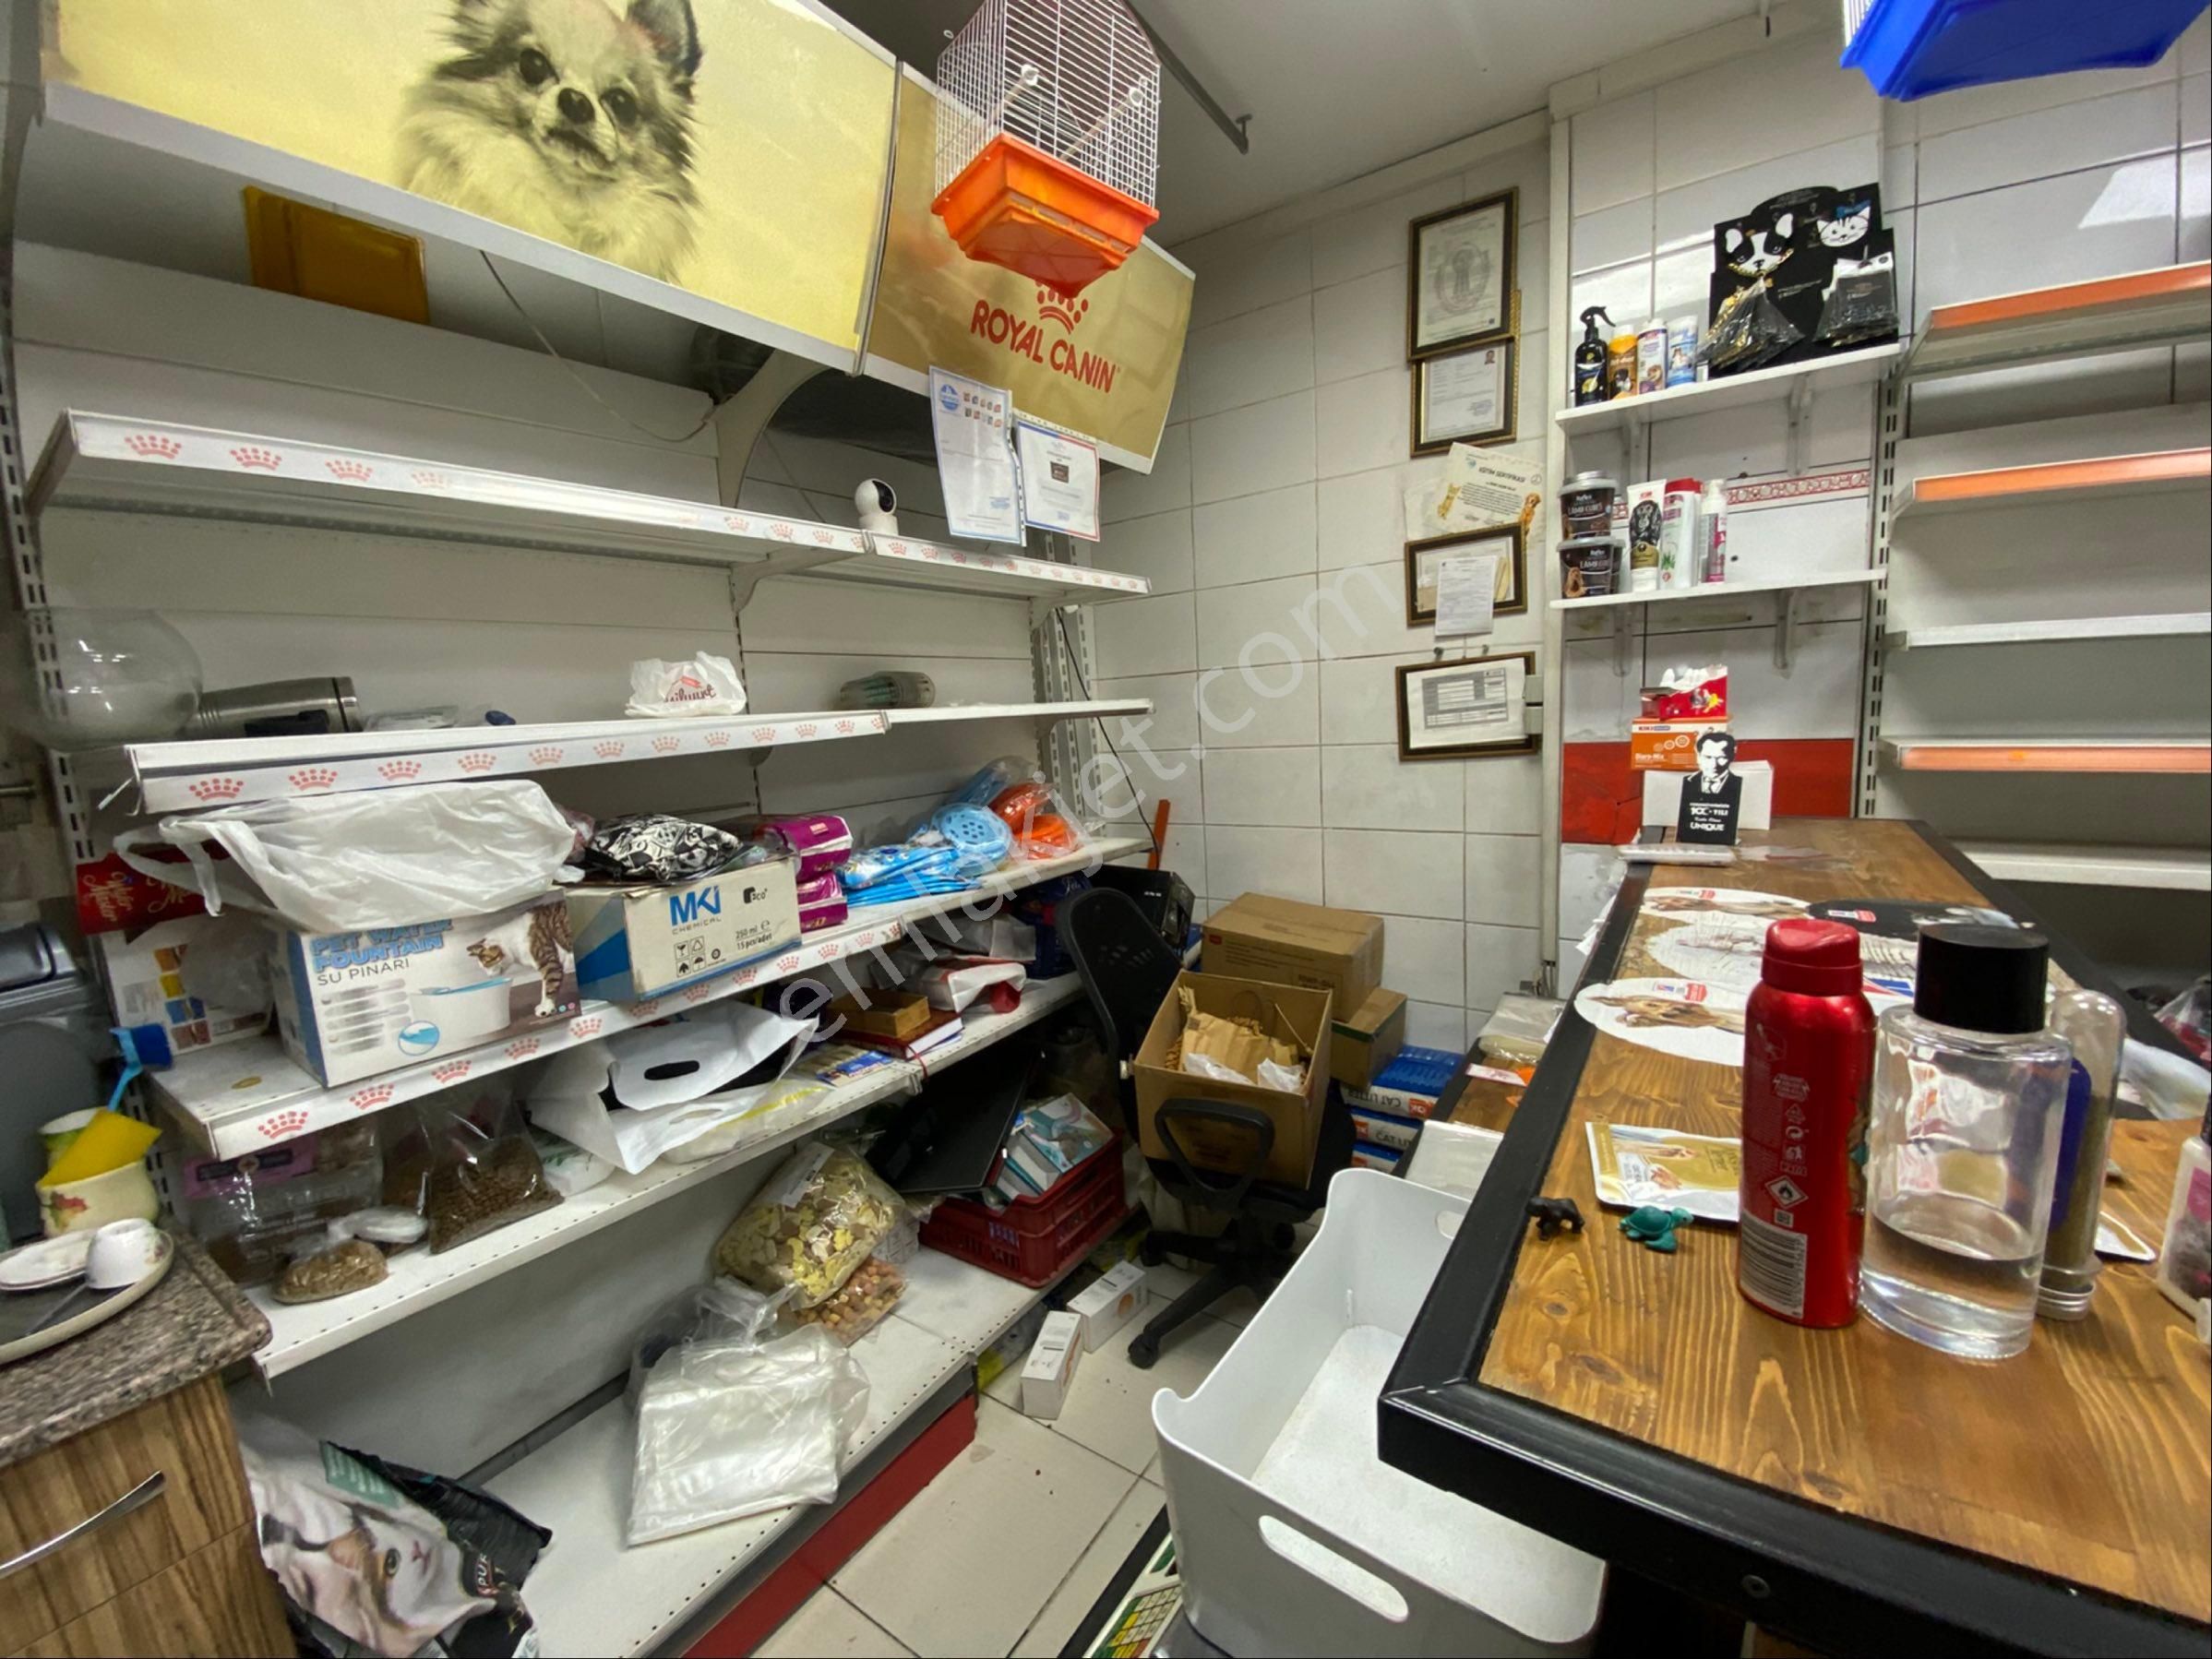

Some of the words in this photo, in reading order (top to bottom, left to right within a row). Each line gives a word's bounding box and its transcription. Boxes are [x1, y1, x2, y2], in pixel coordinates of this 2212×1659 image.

[970, 299, 1044, 364] ROYAL
[1050, 339, 1116, 393] CANIN
[1690, 822, 1725, 831] UNIQUE
[672, 917, 723, 935] CHEMICAL
[735, 925, 748, 939] 250
[312, 929, 362, 956] PET
[314, 934, 445, 973] FOUNTAIN
[317, 973, 342, 986] SU
[349, 958, 411, 981] PINARI
[1381, 1095, 1402, 1108] CAT
[1376, 1131, 1396, 1144] CAT
